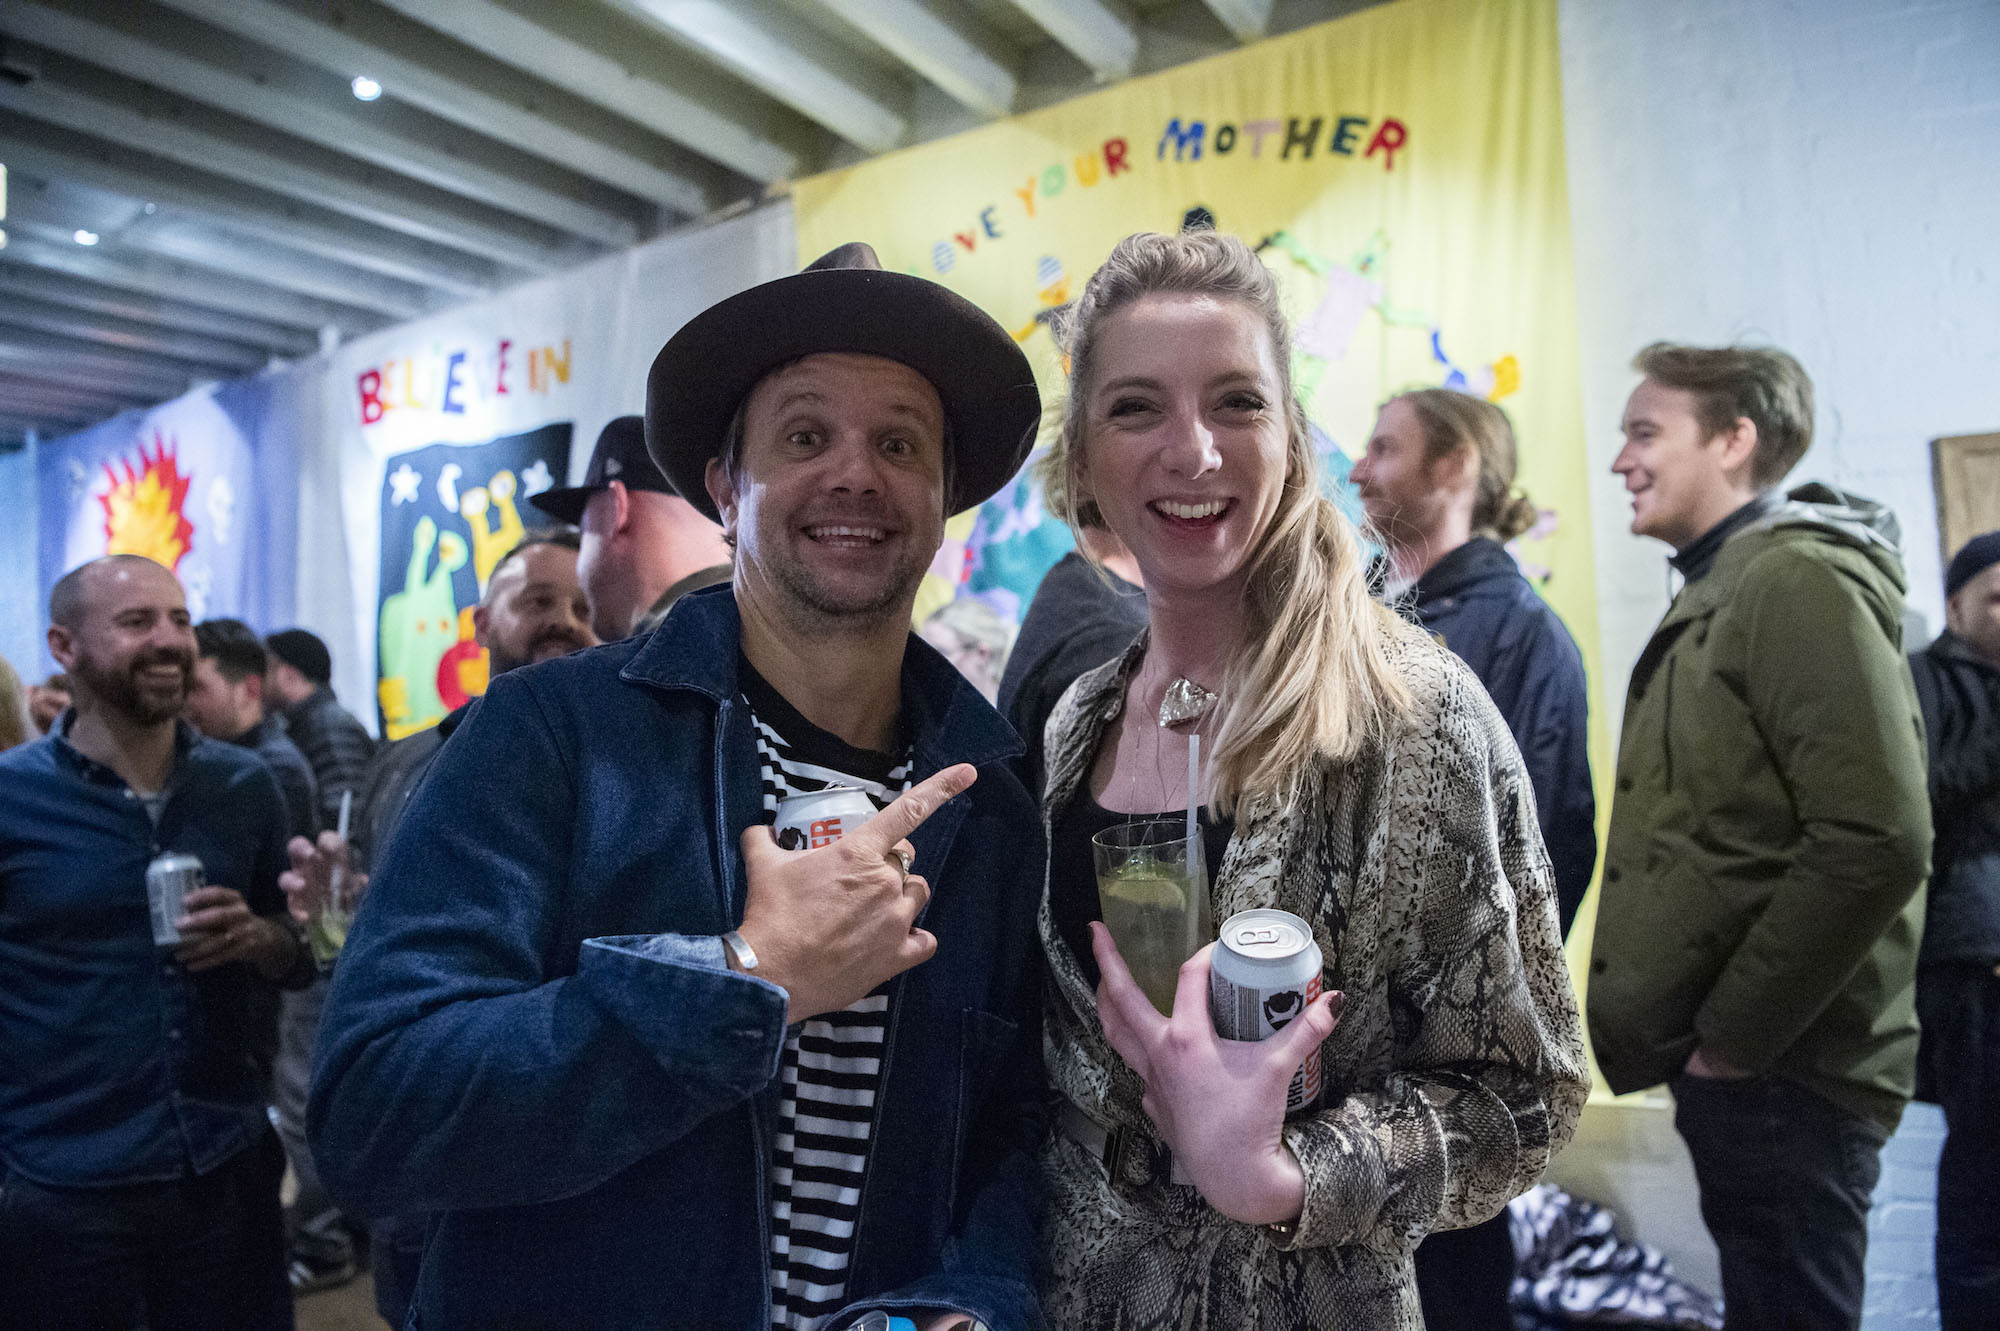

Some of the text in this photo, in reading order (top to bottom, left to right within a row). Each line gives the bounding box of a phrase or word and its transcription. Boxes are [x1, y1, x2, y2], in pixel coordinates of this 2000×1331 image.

[909, 116, 1408, 276] OVE YOUR MOTHER
[528, 338, 571, 394] IN
